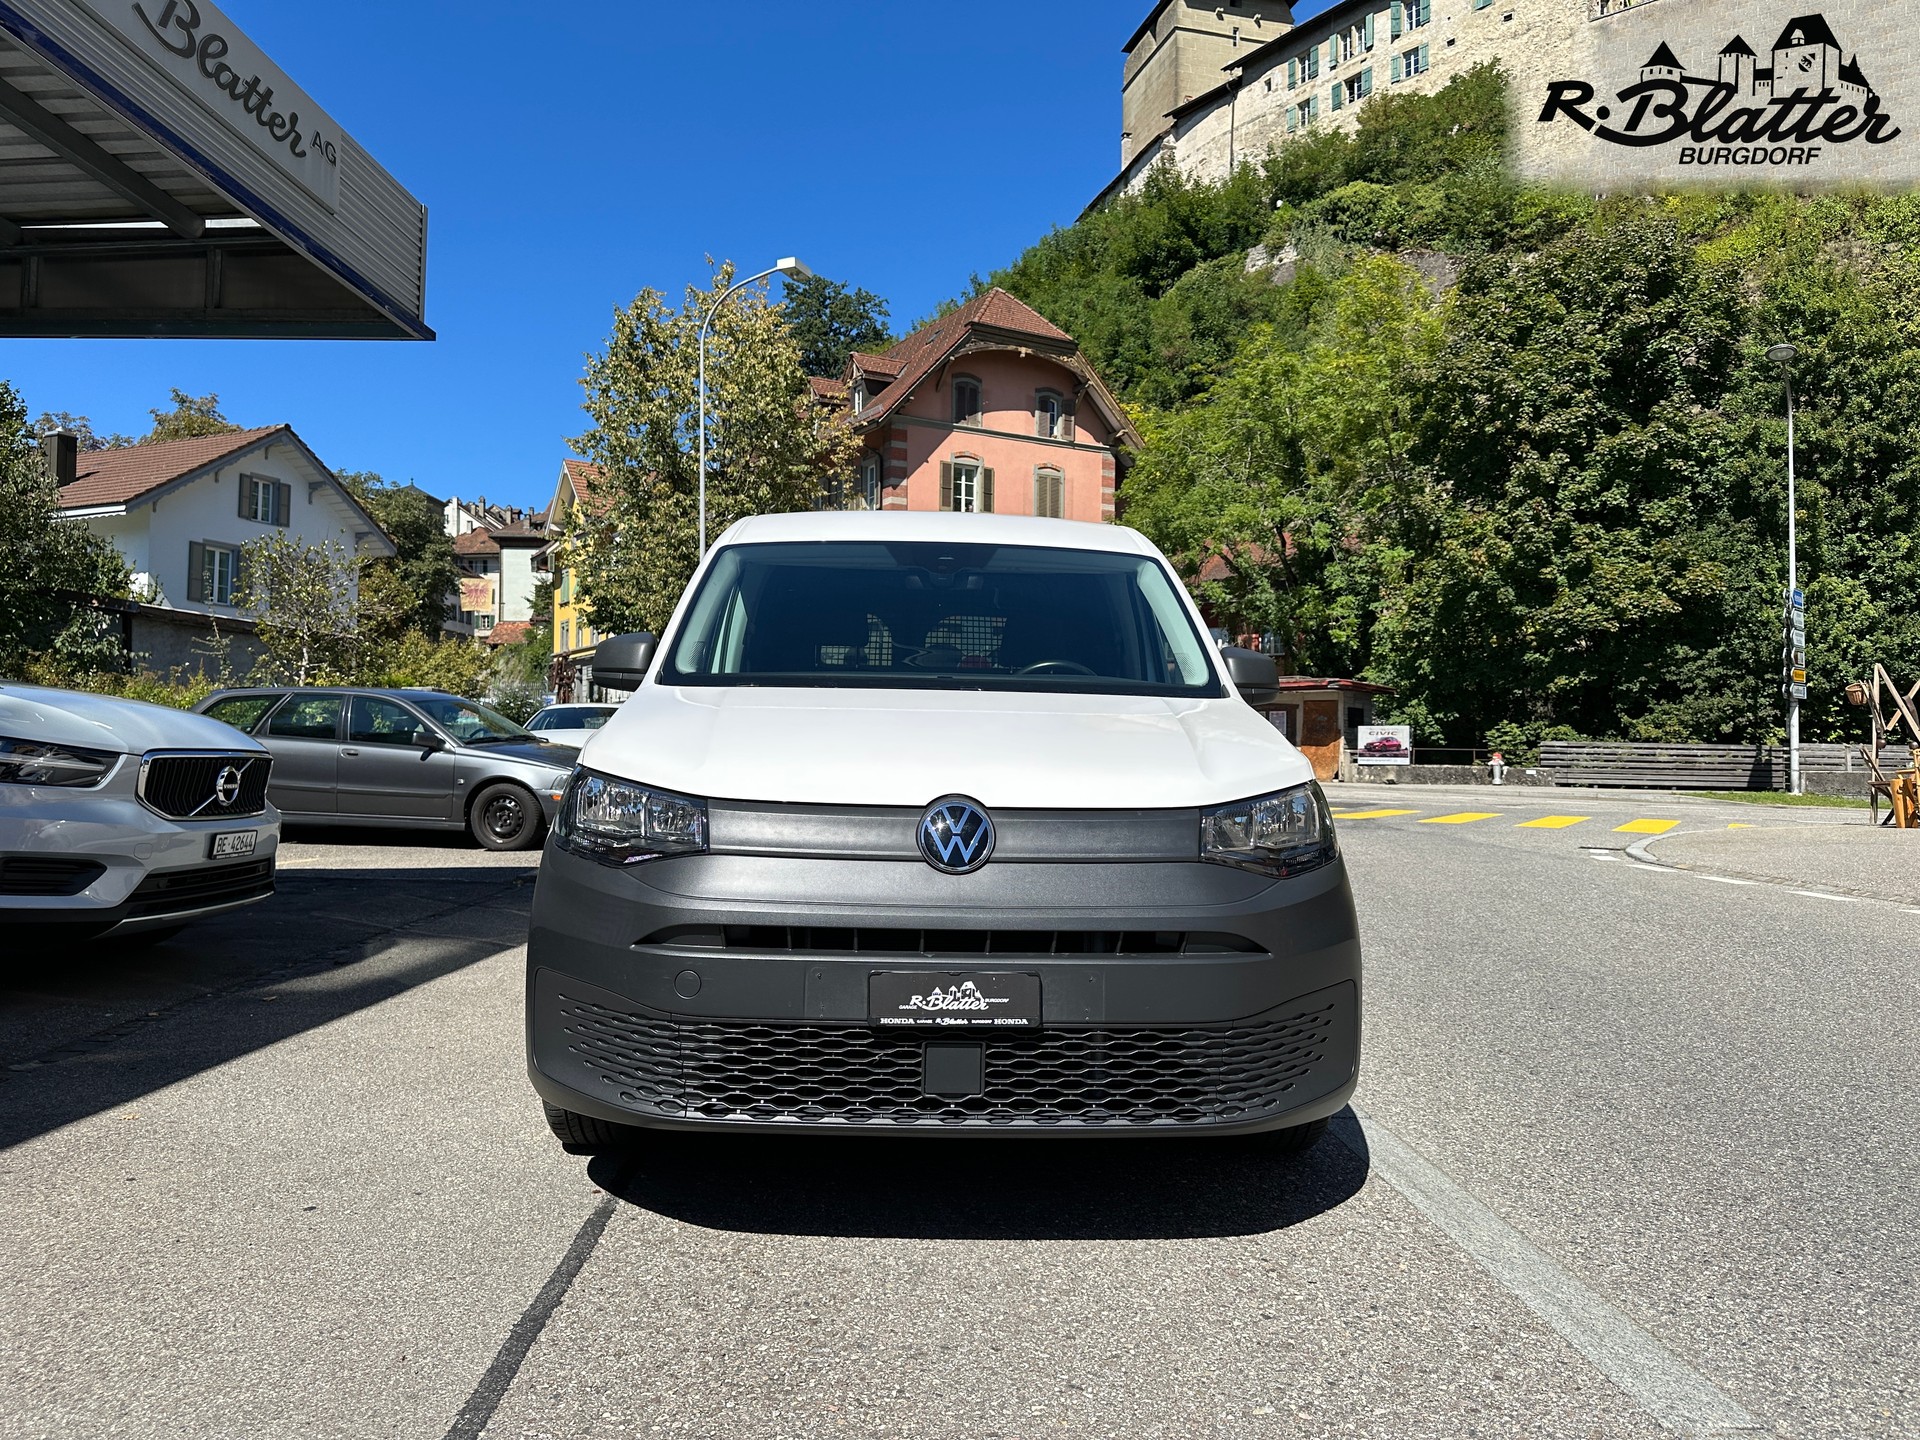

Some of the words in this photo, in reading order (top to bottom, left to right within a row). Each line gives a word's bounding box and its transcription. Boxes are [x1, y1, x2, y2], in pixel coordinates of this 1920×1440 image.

[131, 0, 306, 158] Blatter
[310, 130, 338, 168] AG
[216, 837, 228, 853] BE
[230, 834, 254, 852] 42644
